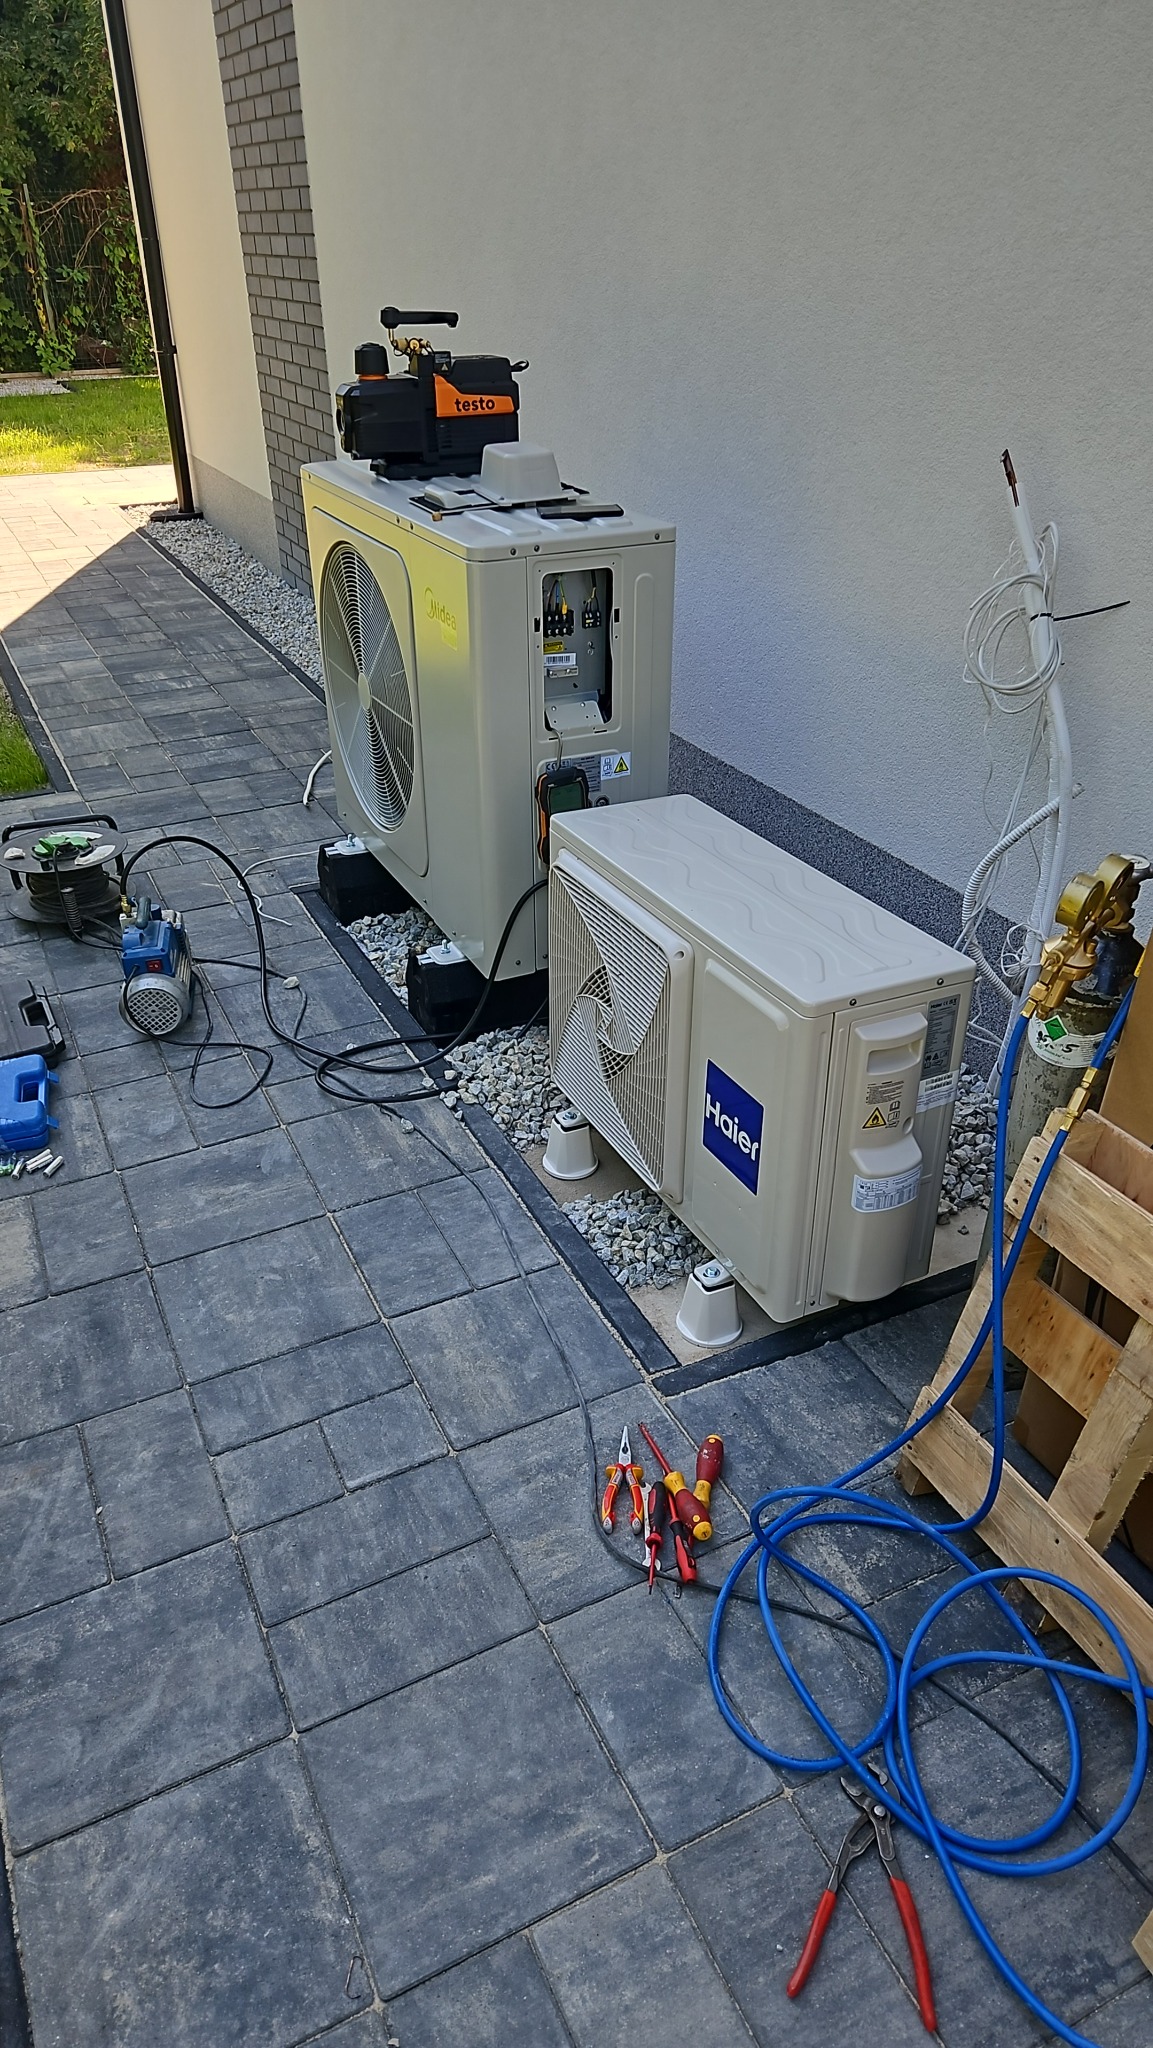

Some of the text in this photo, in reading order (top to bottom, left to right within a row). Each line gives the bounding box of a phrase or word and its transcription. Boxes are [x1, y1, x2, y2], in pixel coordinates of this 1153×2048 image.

[454, 396, 495, 412] testo
[425, 588, 457, 631] Midea
[705, 1092, 759, 1161] Haier
